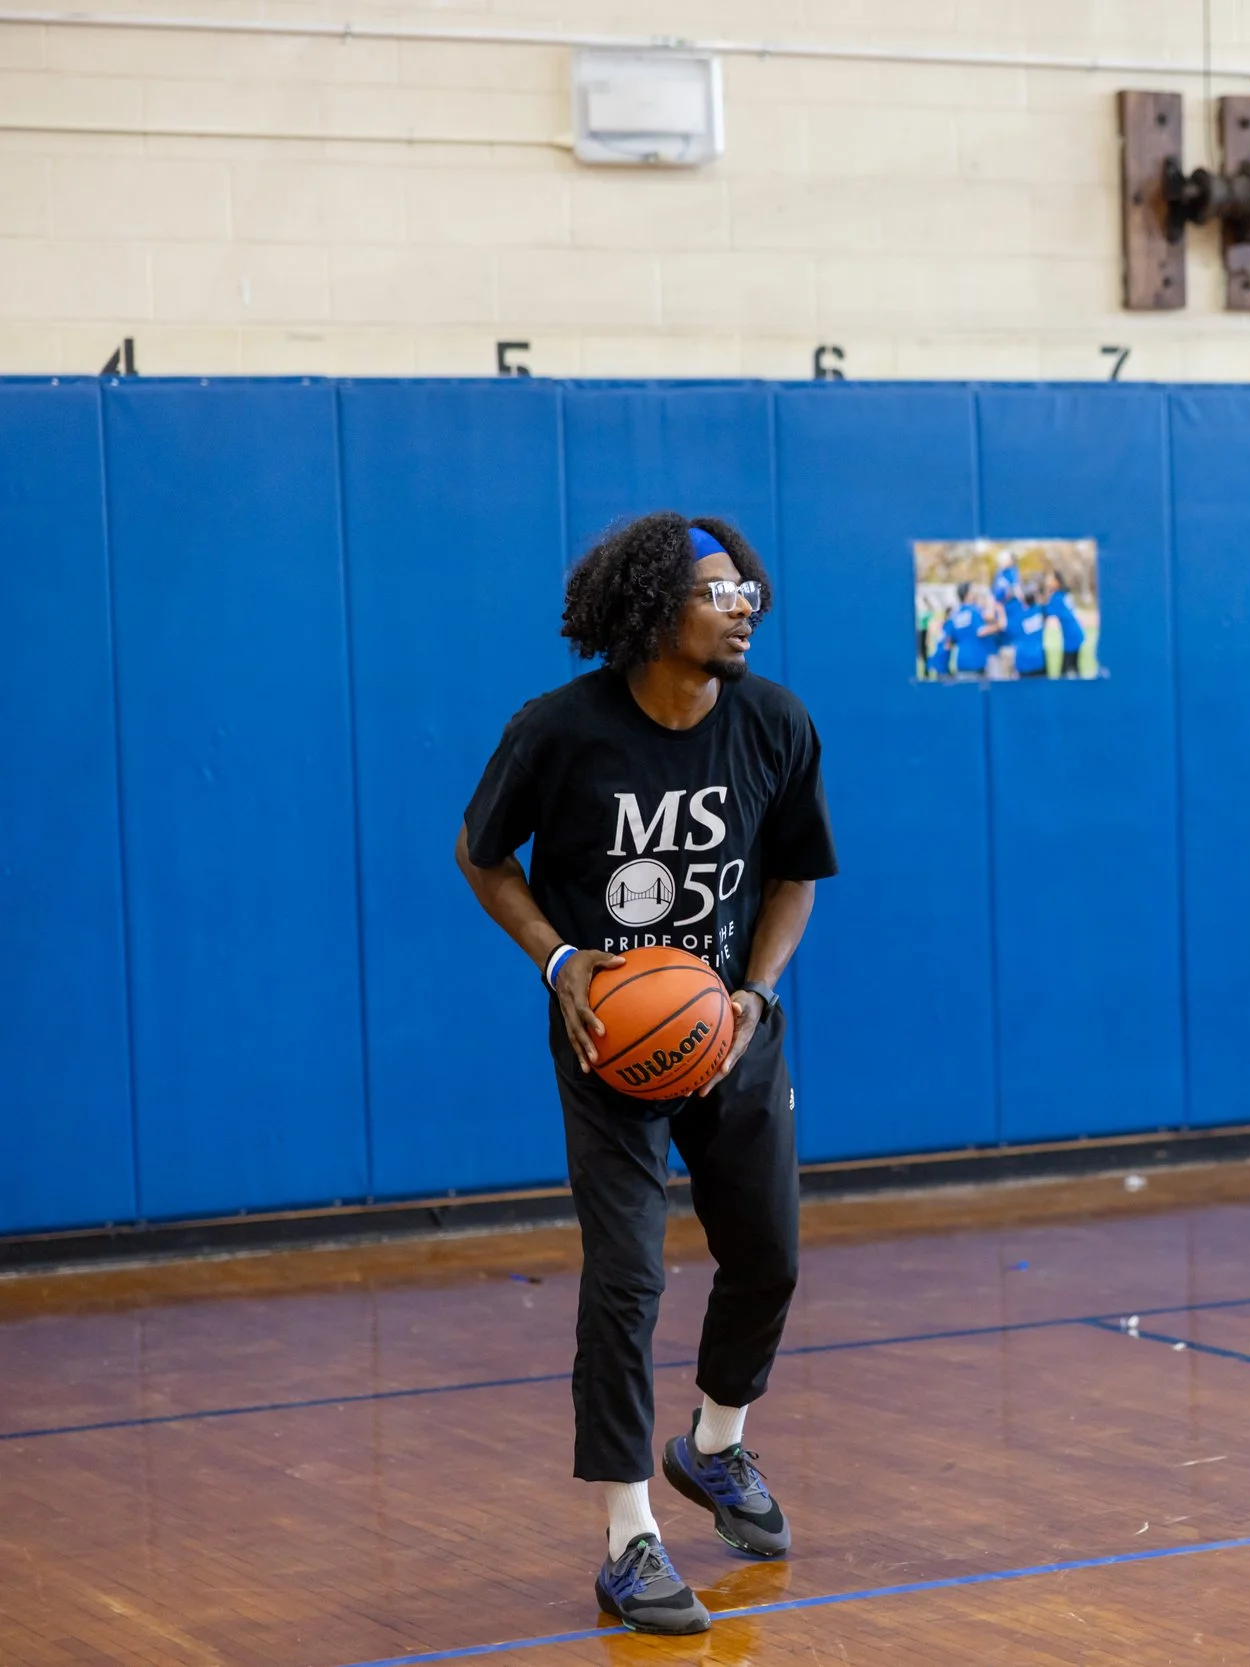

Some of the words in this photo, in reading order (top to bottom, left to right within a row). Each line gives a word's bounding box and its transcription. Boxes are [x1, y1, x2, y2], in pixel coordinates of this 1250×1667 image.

[1100, 347, 1131, 381] 7
[606, 786, 728, 856] MS
[673, 859, 745, 927] 50
[682, 934, 713, 950] OF
[616, 1020, 711, 1087] Wilson
